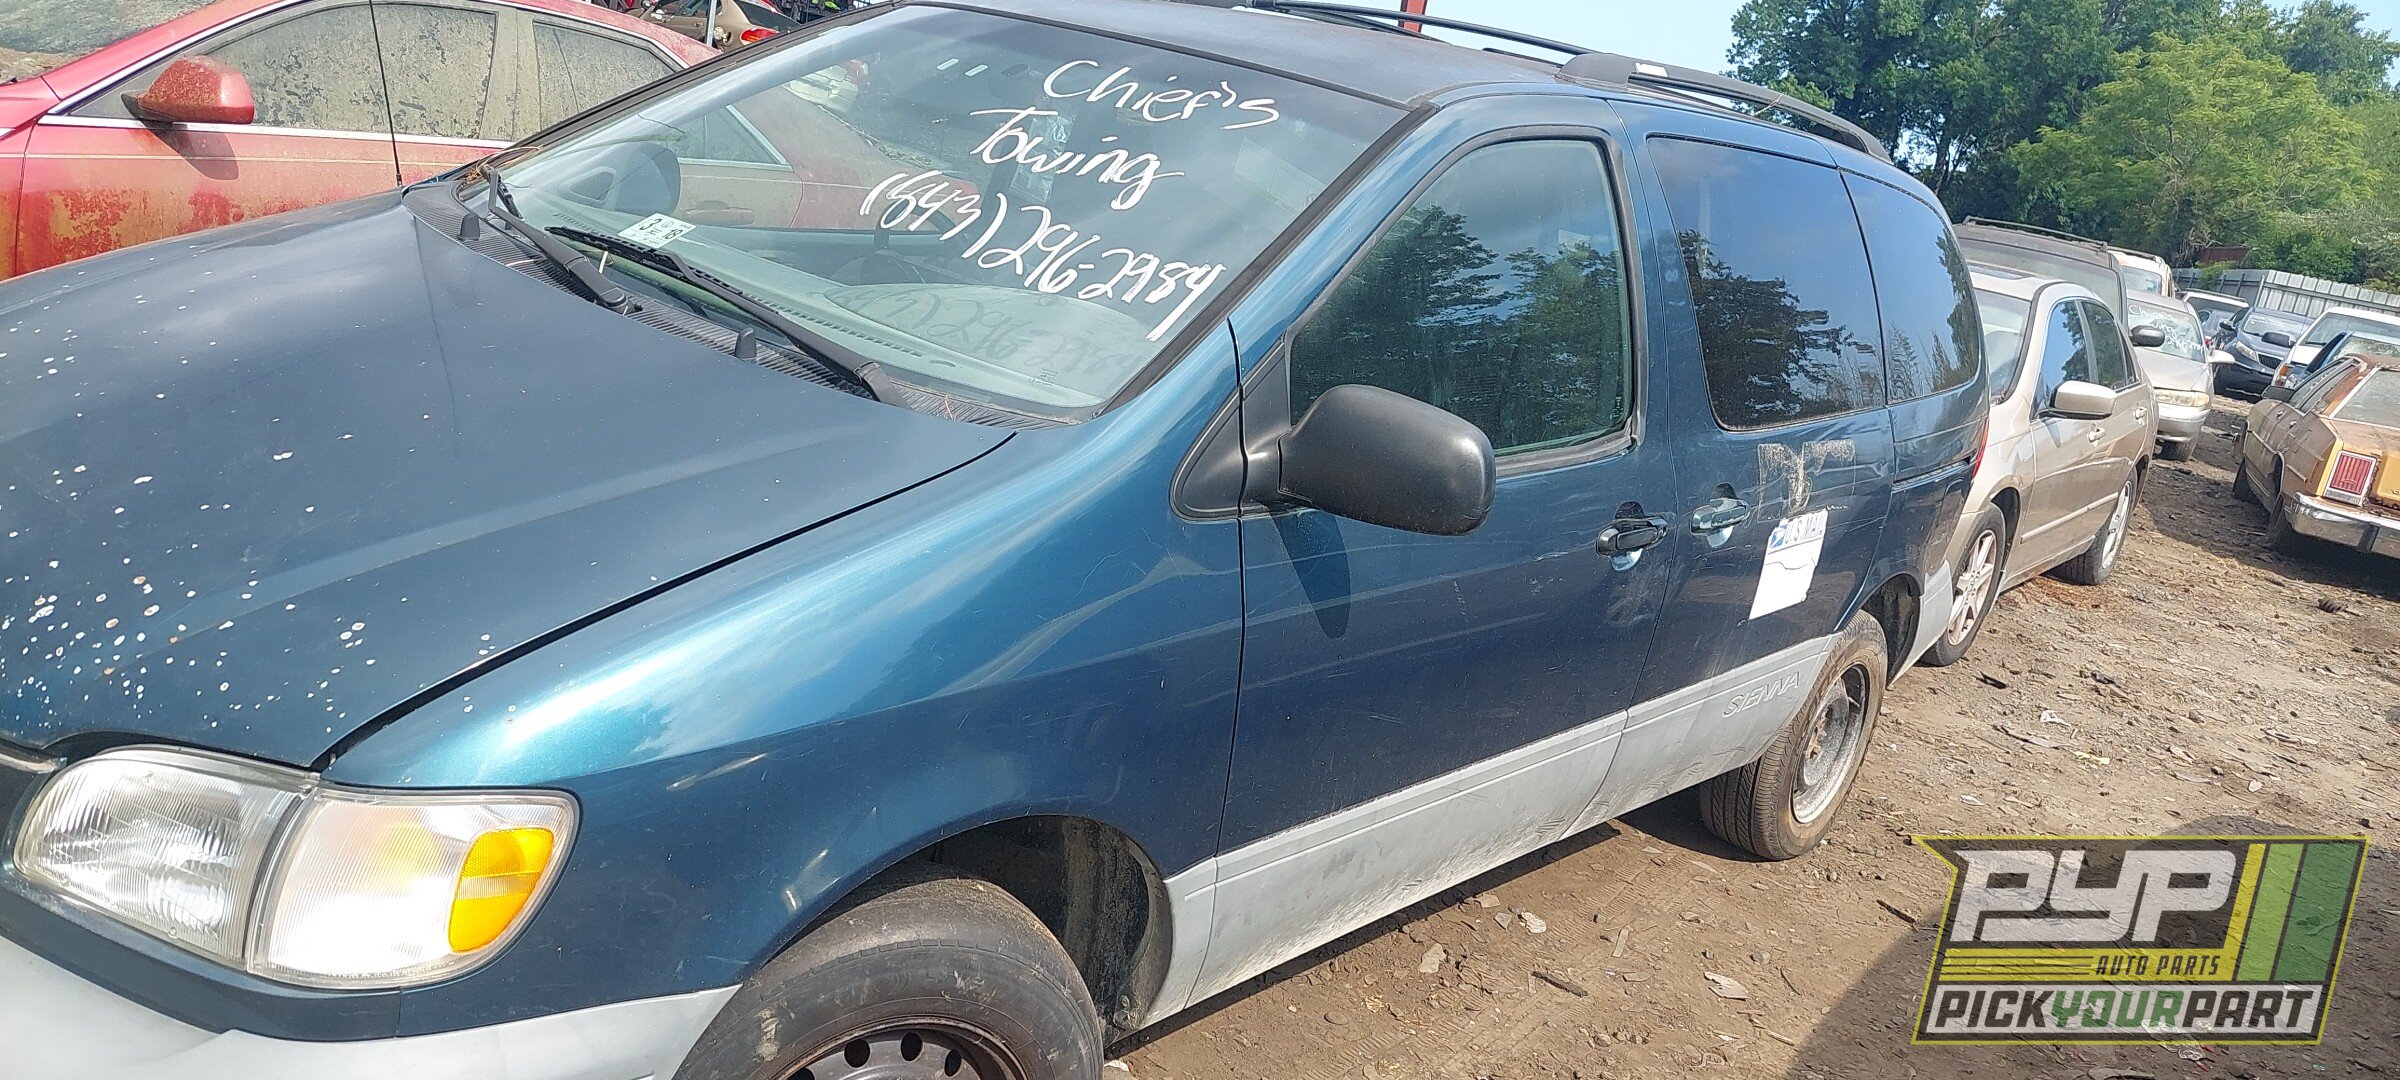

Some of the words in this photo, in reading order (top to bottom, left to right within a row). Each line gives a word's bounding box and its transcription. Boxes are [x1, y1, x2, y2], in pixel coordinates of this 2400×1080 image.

[1043, 60, 1280, 130] Chief's
[969, 106, 1185, 210] Towing
[1721, 671, 1800, 718] SIENNA
